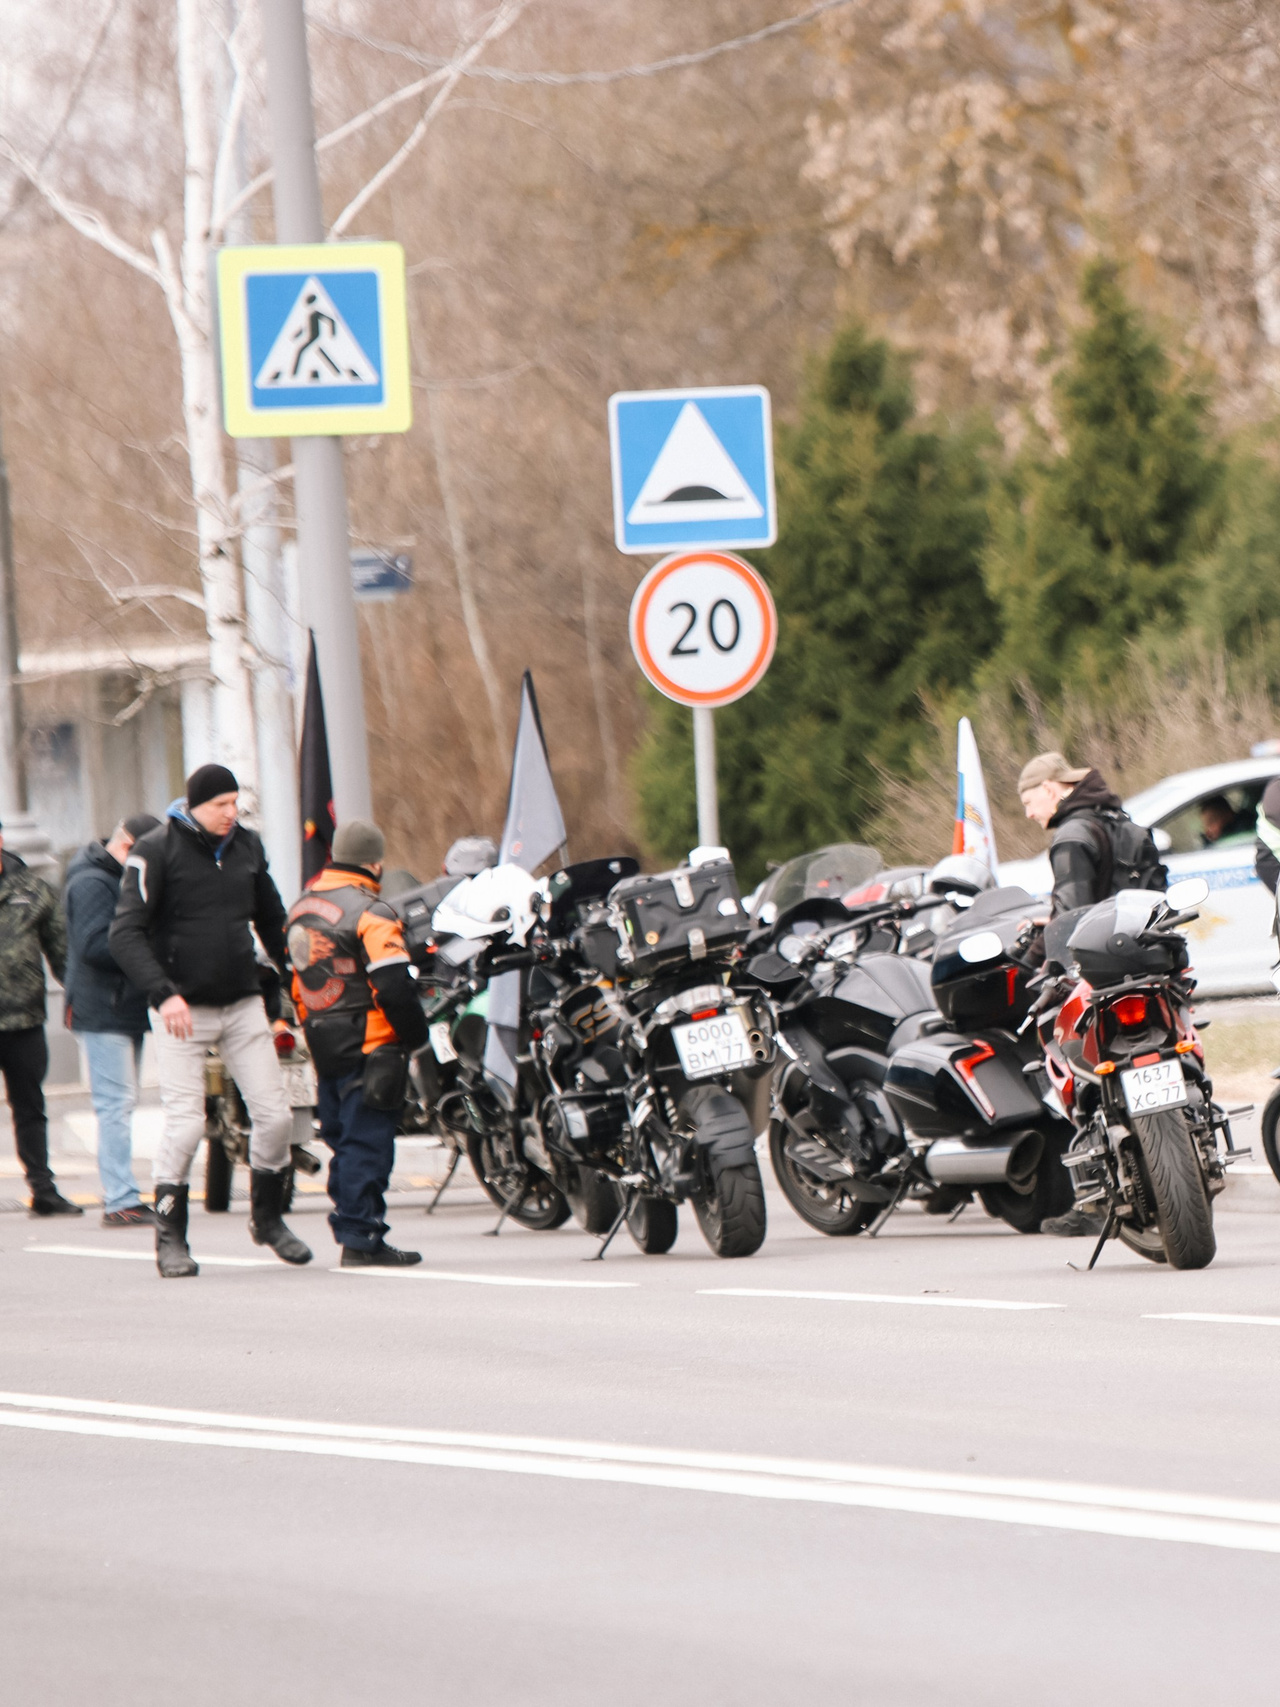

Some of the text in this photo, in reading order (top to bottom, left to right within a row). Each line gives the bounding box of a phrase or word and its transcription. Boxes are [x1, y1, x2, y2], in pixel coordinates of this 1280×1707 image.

[668, 599, 740, 655] 20
[687, 1022, 732, 1044] 6000
[687, 1043, 743, 1069] ВМ 77
[1133, 1064, 1171, 1085] 1637
[1132, 1085, 1180, 1110] ХС 77
